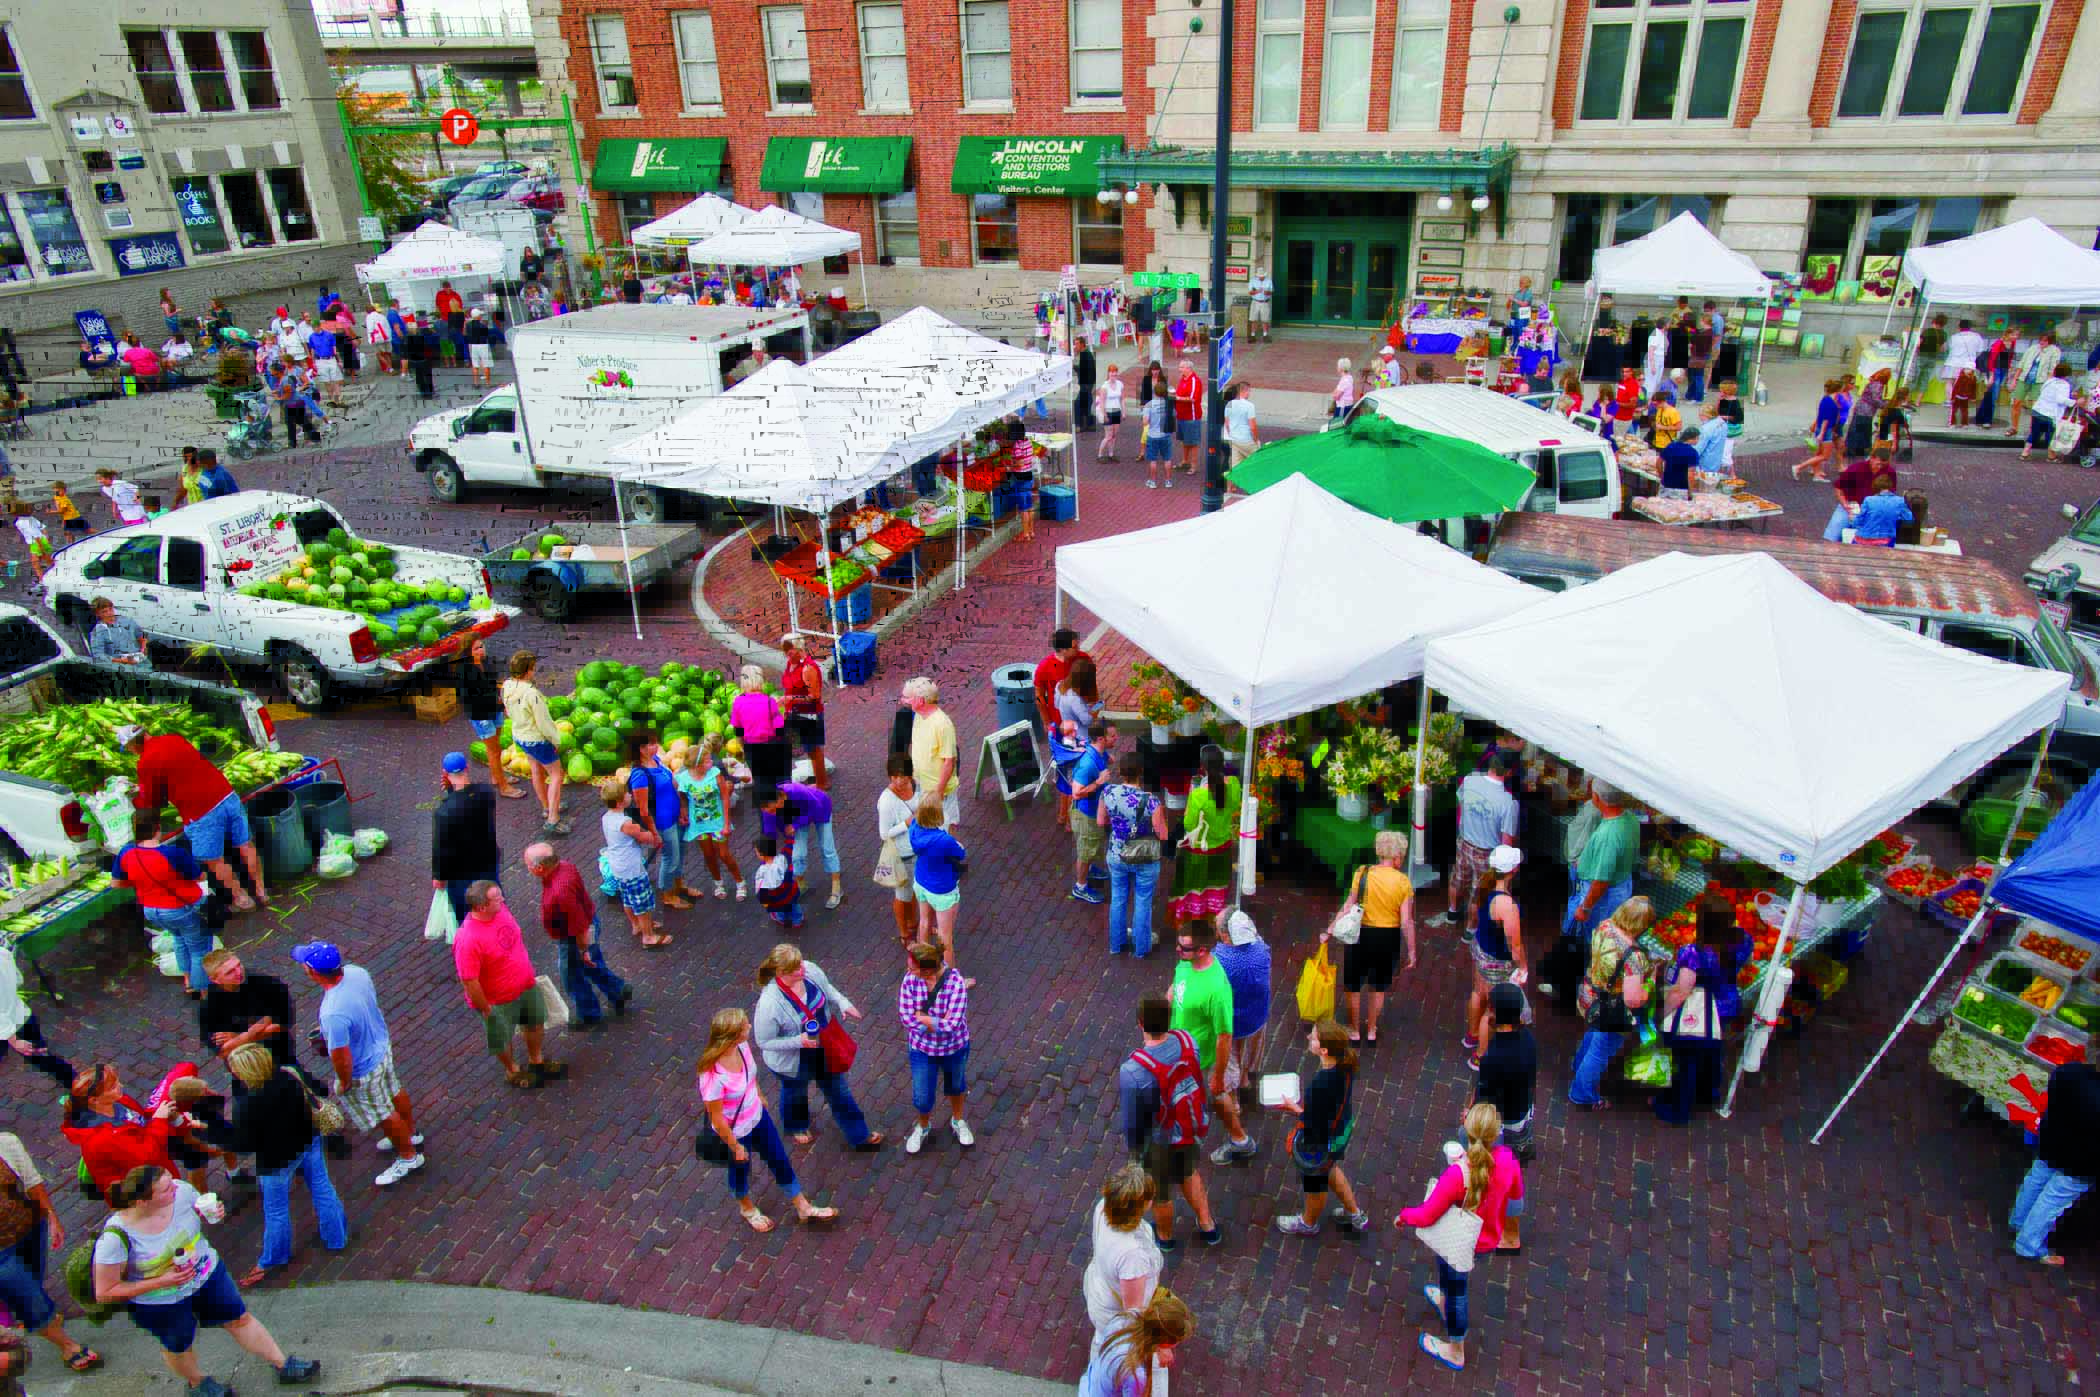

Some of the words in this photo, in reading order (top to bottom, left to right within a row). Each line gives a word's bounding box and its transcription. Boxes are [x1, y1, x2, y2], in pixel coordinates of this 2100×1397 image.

[453, 114, 469, 140] P
[1004, 141, 1084, 154] LINCOLN
[1005, 154, 1069, 162] CONVENTION
[1002, 163, 1024, 171] AND
[1027, 163, 1071, 171] VISITORS
[997, 185, 1031, 193] Visitors
[1034, 185, 1065, 194] Center
[184, 216, 217, 226] BOOKS
[141, 239, 176, 256] indigo
[146, 250, 178, 266] BRIDGE
[1141, 275, 1149, 285] N
[1156, 275, 1171, 286] 7TH
[1178, 276, 1192, 287] ST
[607, 354, 639, 371] Produce
[219, 522, 236, 535] ST.
[236, 508, 265, 529] LIBORY
